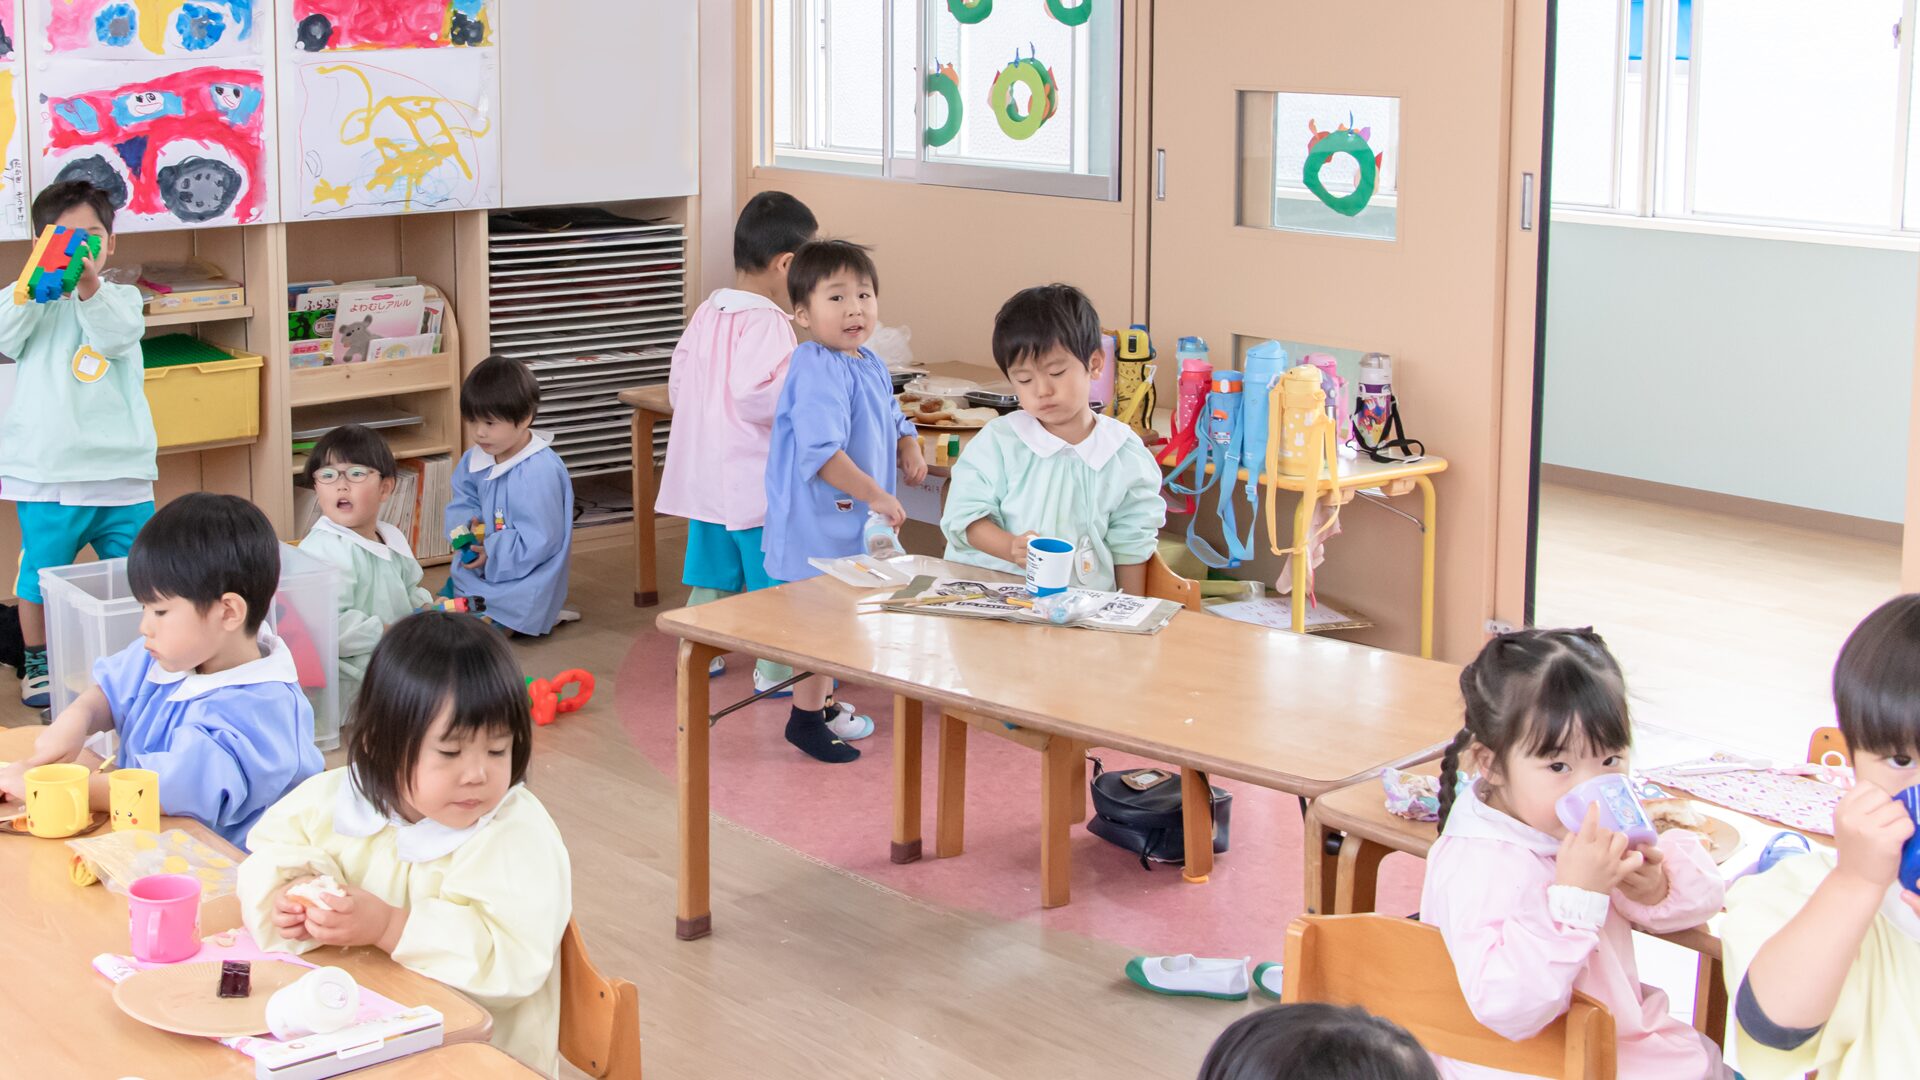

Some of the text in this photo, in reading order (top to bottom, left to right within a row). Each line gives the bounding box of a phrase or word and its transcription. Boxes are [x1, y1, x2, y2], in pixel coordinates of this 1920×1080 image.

[350, 299, 411, 312] よわむしアルル
